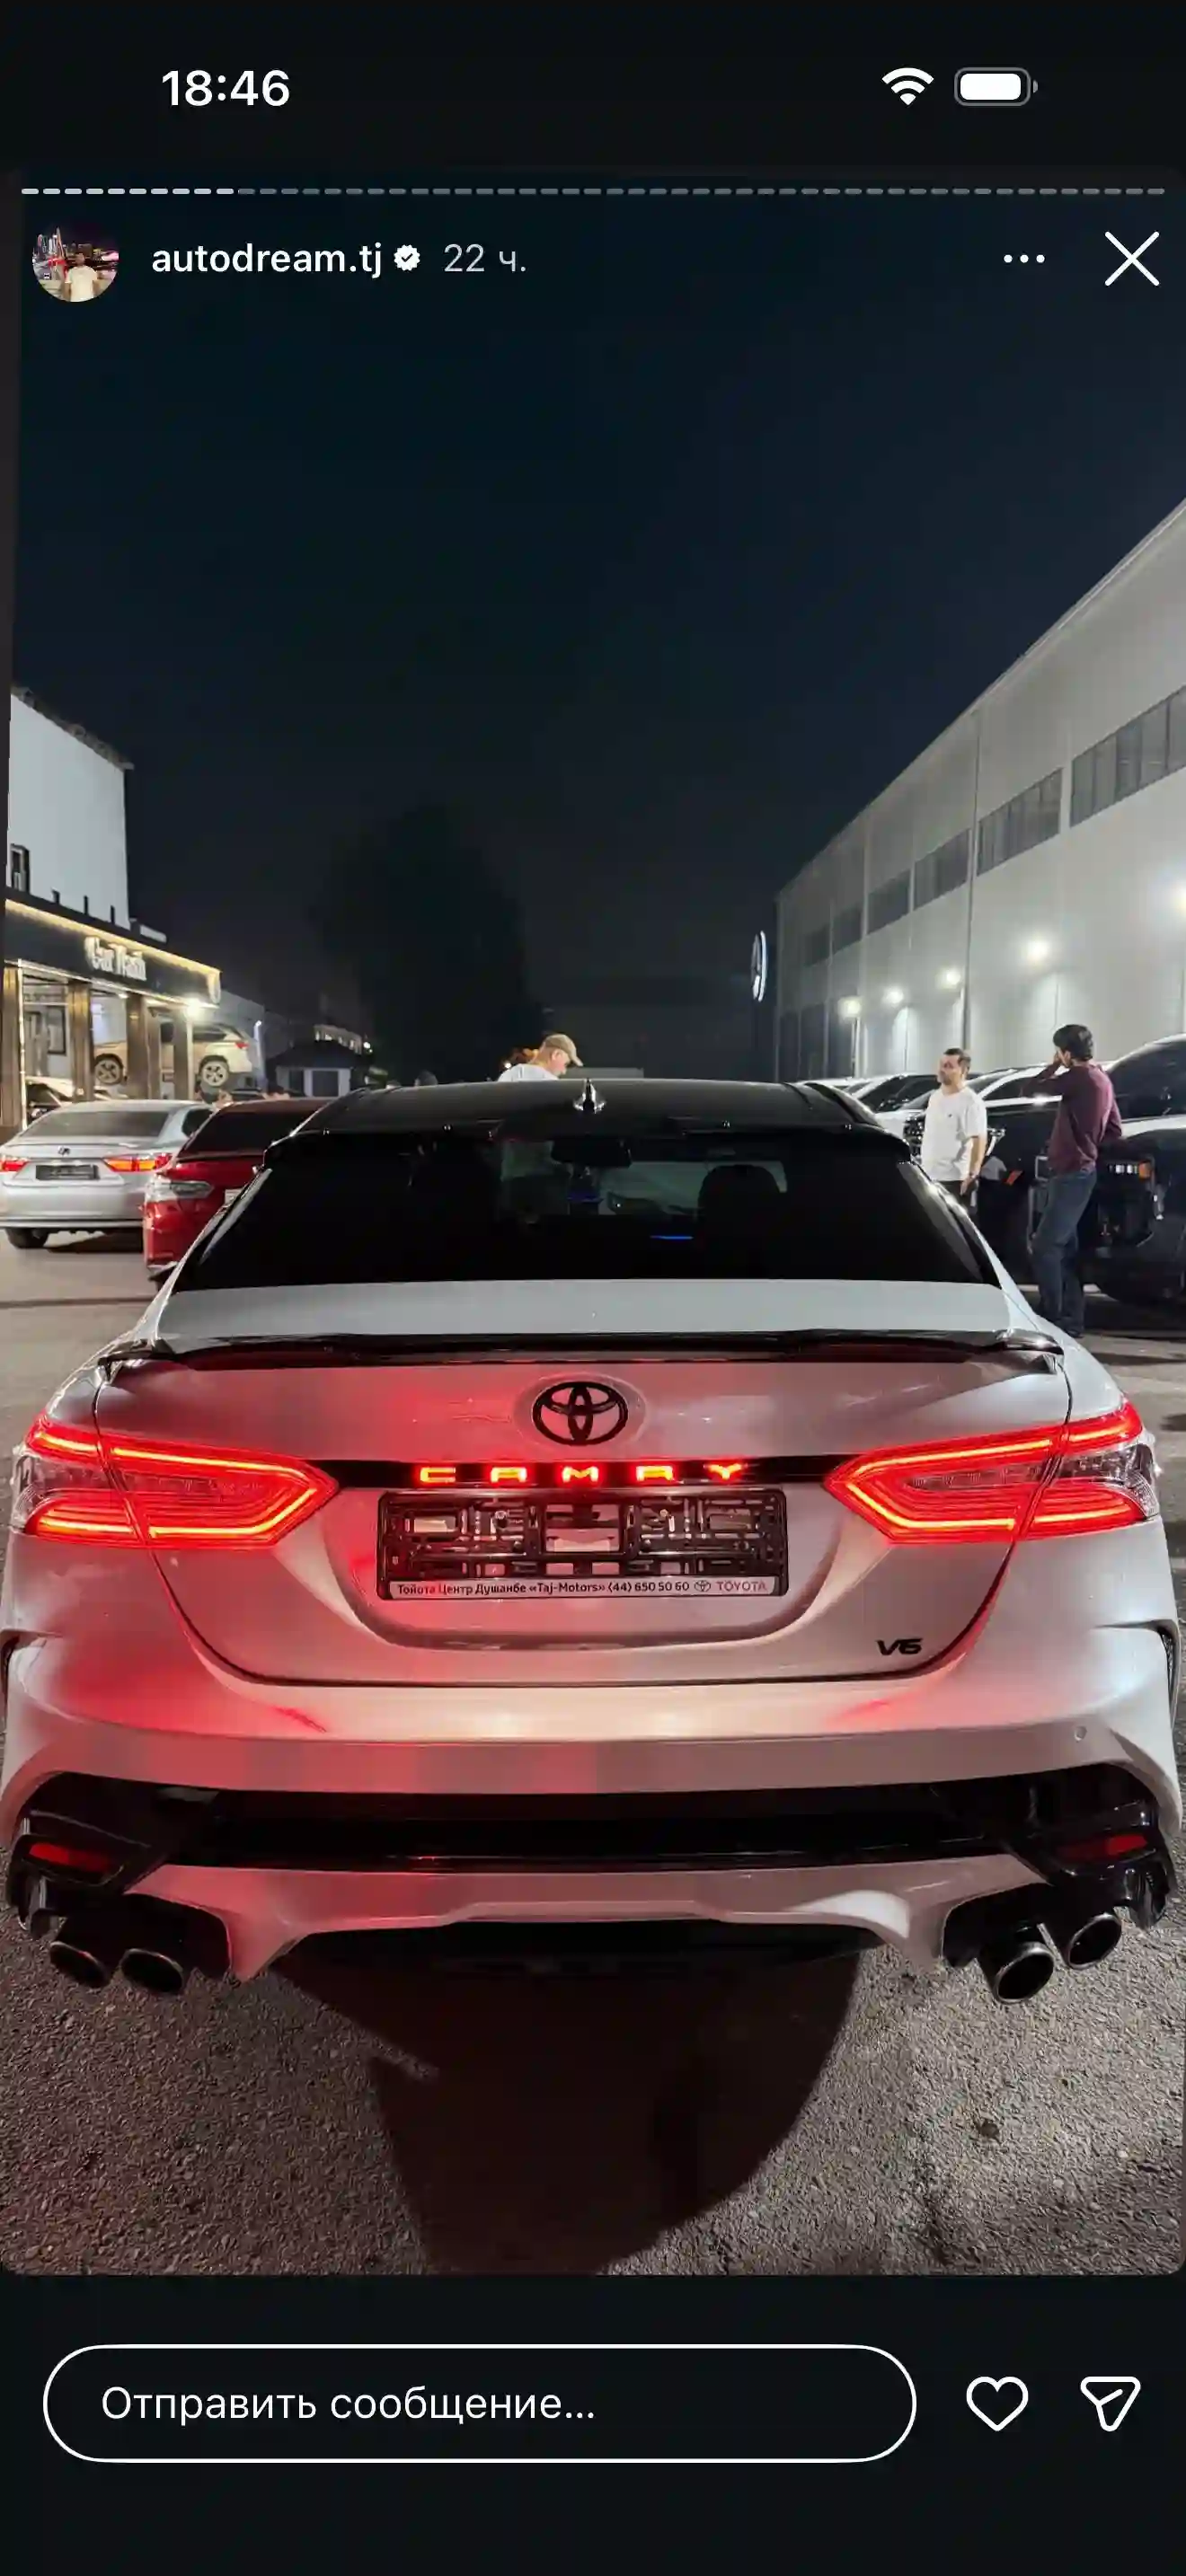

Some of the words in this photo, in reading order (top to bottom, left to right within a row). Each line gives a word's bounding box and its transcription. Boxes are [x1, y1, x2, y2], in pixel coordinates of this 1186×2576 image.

[84, 937, 114, 972] Car
[420, 1463, 748, 1484] CAMRY
[398, 1584, 435, 1595] Тойота
[438, 1583, 472, 1596] Центр
[474, 1582, 527, 1595] Душанбе
[529, 1581, 605, 1594] «Taj-Motors»
[607, 1581, 632, 1592] (44)
[634, 1582, 656, 1592] 650
[658, 1582, 672, 1592] 50
[675, 1581, 690, 1592] 60
[716, 1581, 767, 1592] TOYOTA
[876, 1637, 923, 1655] V6
